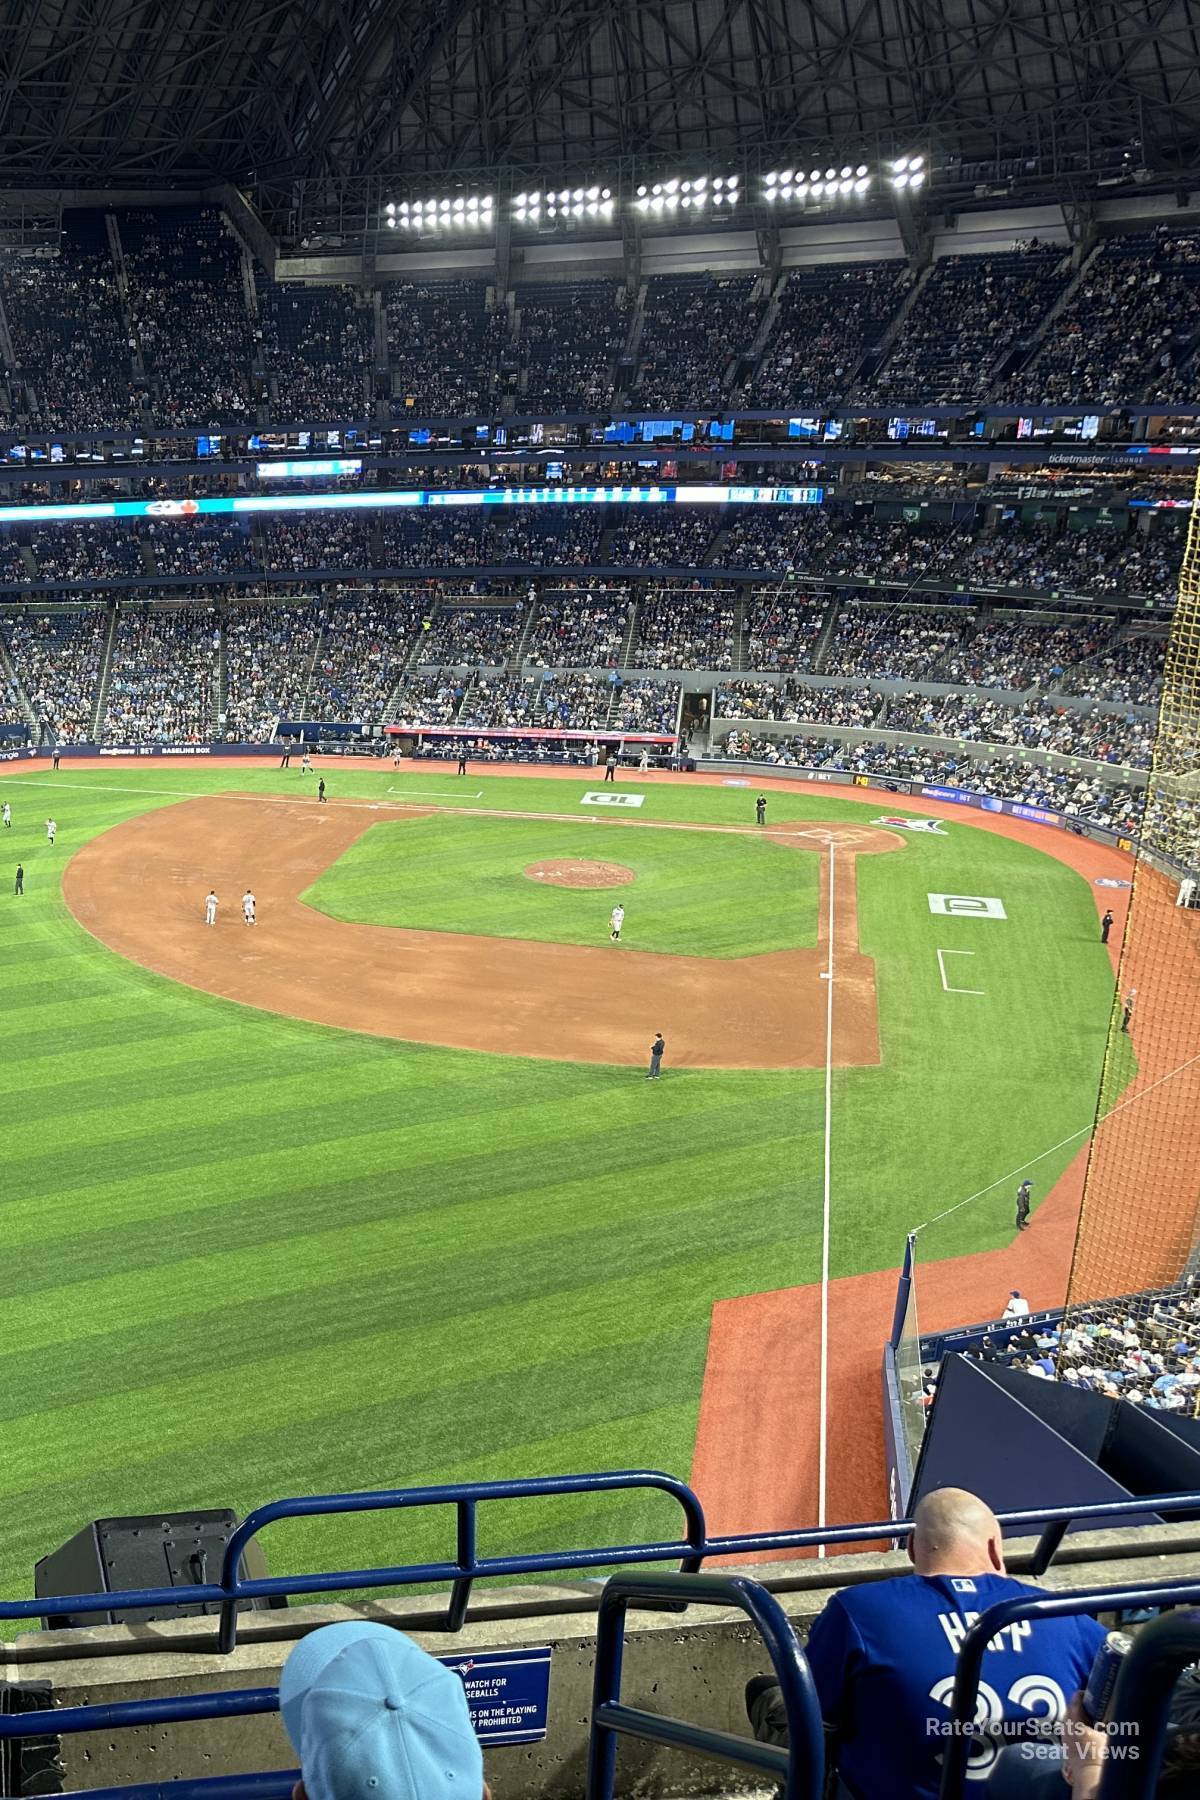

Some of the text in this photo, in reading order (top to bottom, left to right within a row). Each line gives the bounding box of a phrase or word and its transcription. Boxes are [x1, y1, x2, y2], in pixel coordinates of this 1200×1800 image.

[1049, 454, 1106, 464] ticketmaster
[465, 1678, 507, 1689] WATCH FOR
[466, 1688, 498, 1698] SEBALLS
[479, 1710, 489, 1718] ON
[491, 1708, 505, 1717] THE
[507, 1705, 537, 1715] PLAYING
[479, 1716, 521, 1727] PROHIBITED
